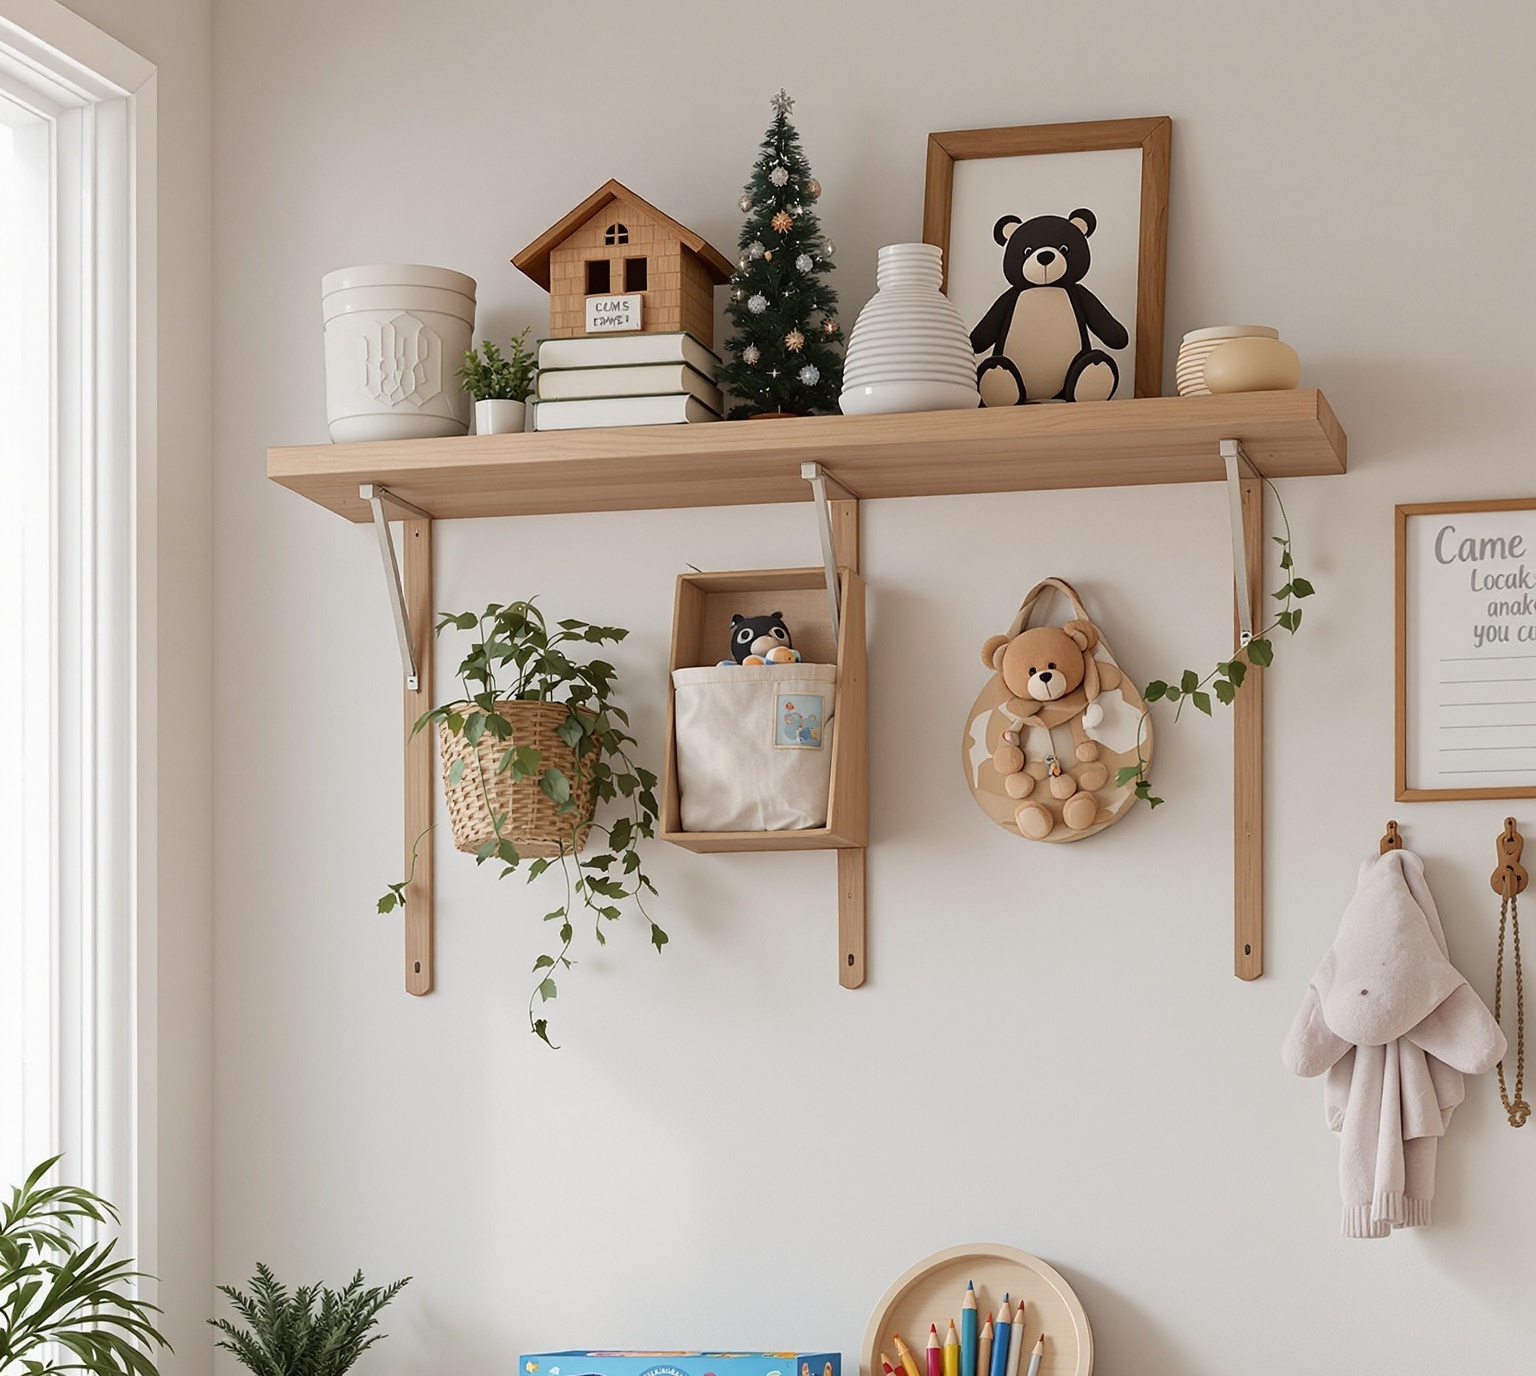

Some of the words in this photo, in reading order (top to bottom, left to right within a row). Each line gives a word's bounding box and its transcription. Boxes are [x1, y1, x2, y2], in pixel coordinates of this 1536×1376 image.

[1434, 525, 1527, 565] Came
[1470, 564, 1536, 592] Locak
[1487, 592, 1536, 617] anak
[1473, 625, 1510, 649] you
